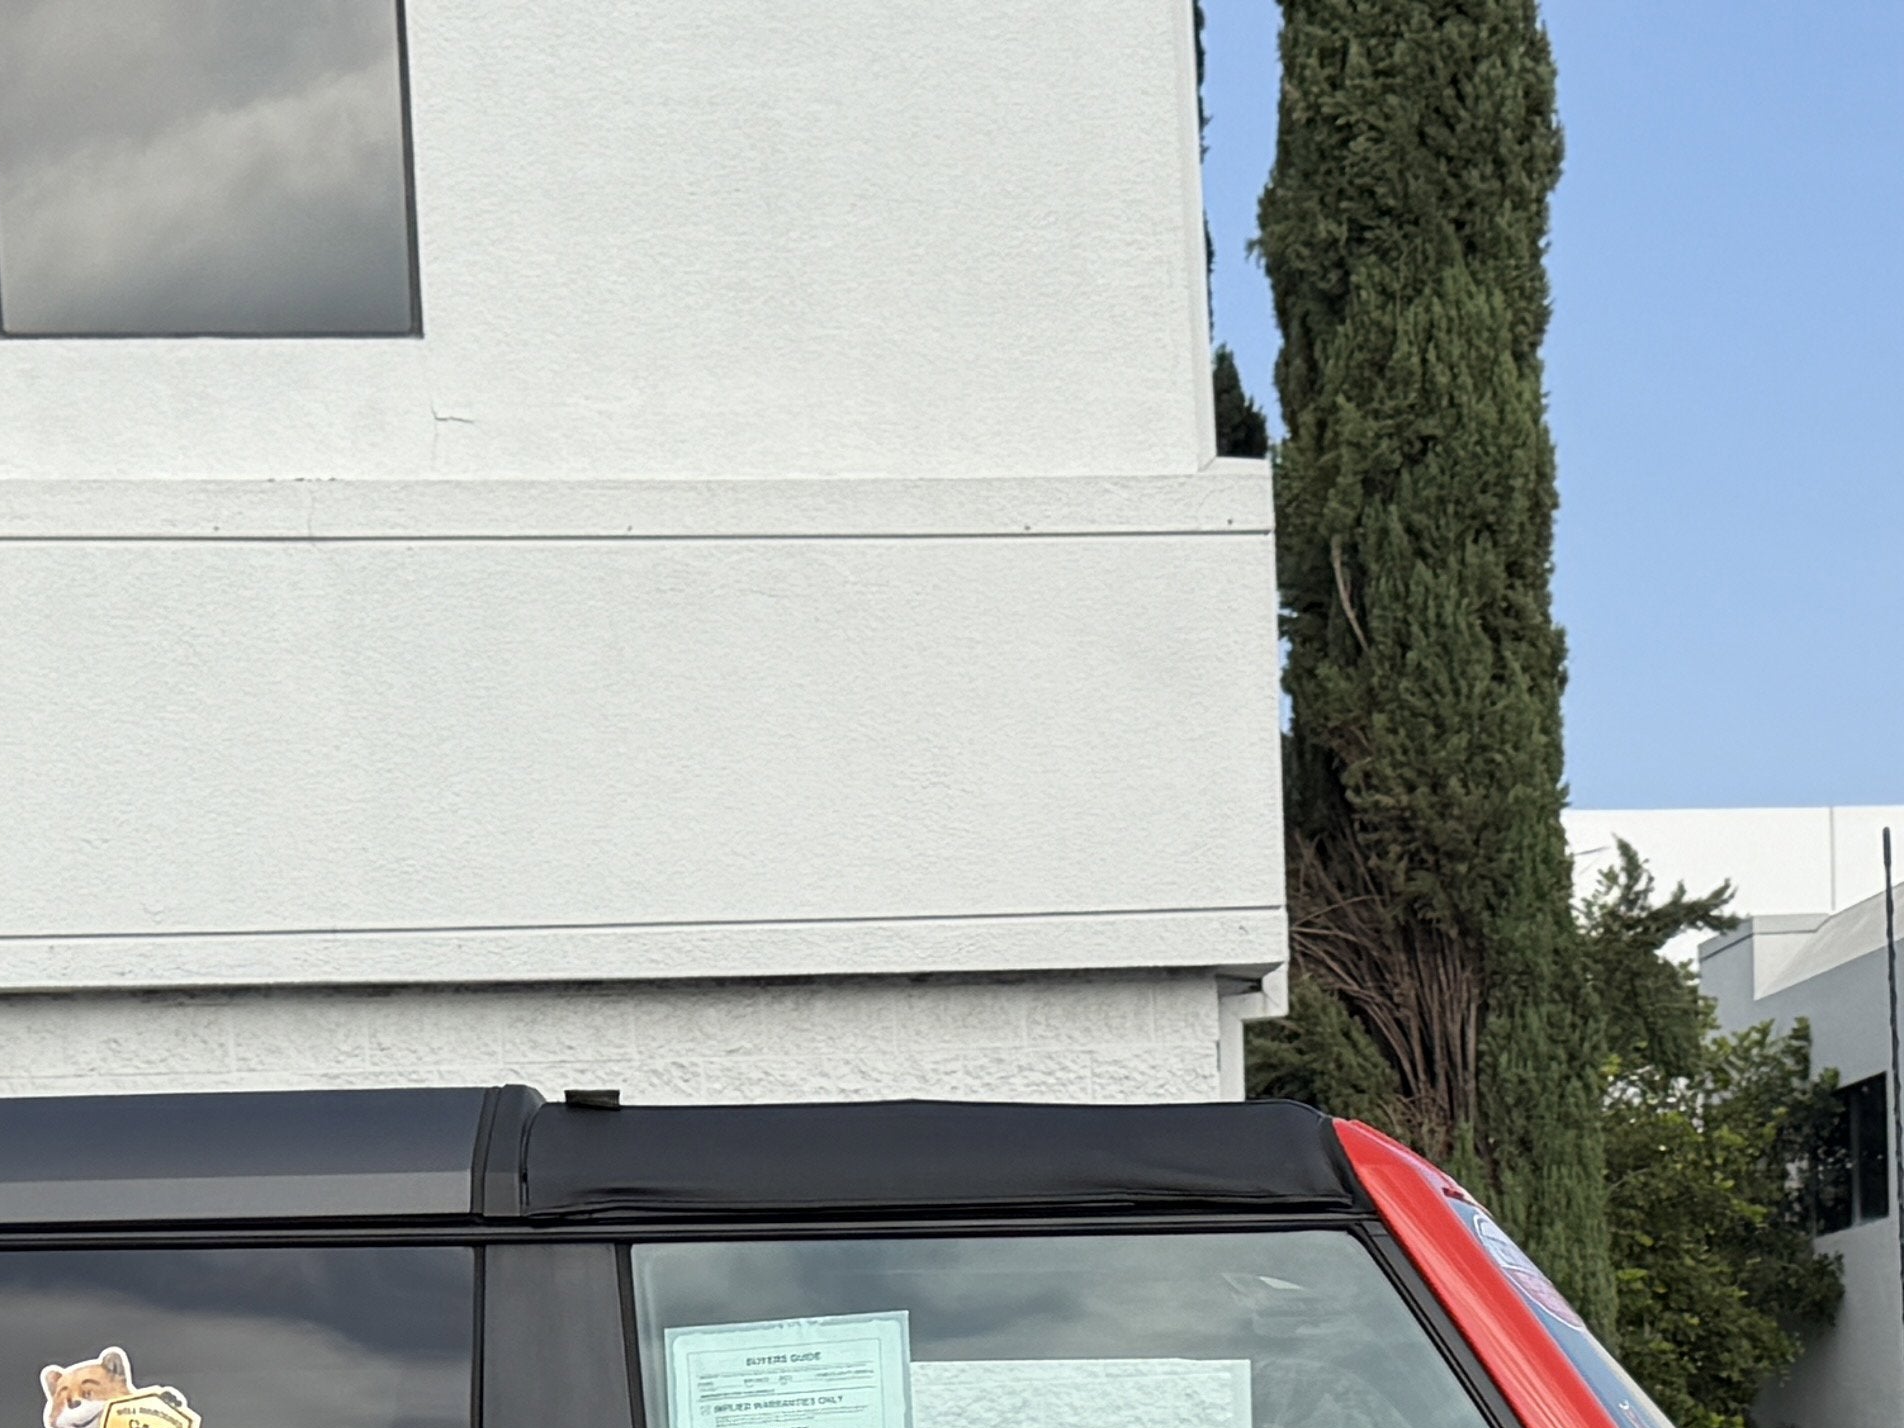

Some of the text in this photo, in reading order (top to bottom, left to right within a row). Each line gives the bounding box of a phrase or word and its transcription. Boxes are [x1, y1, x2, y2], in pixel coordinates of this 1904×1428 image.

[746, 1351, 822, 1367] BUYERS GUIDE
[817, 1394, 844, 1405] ONLY
